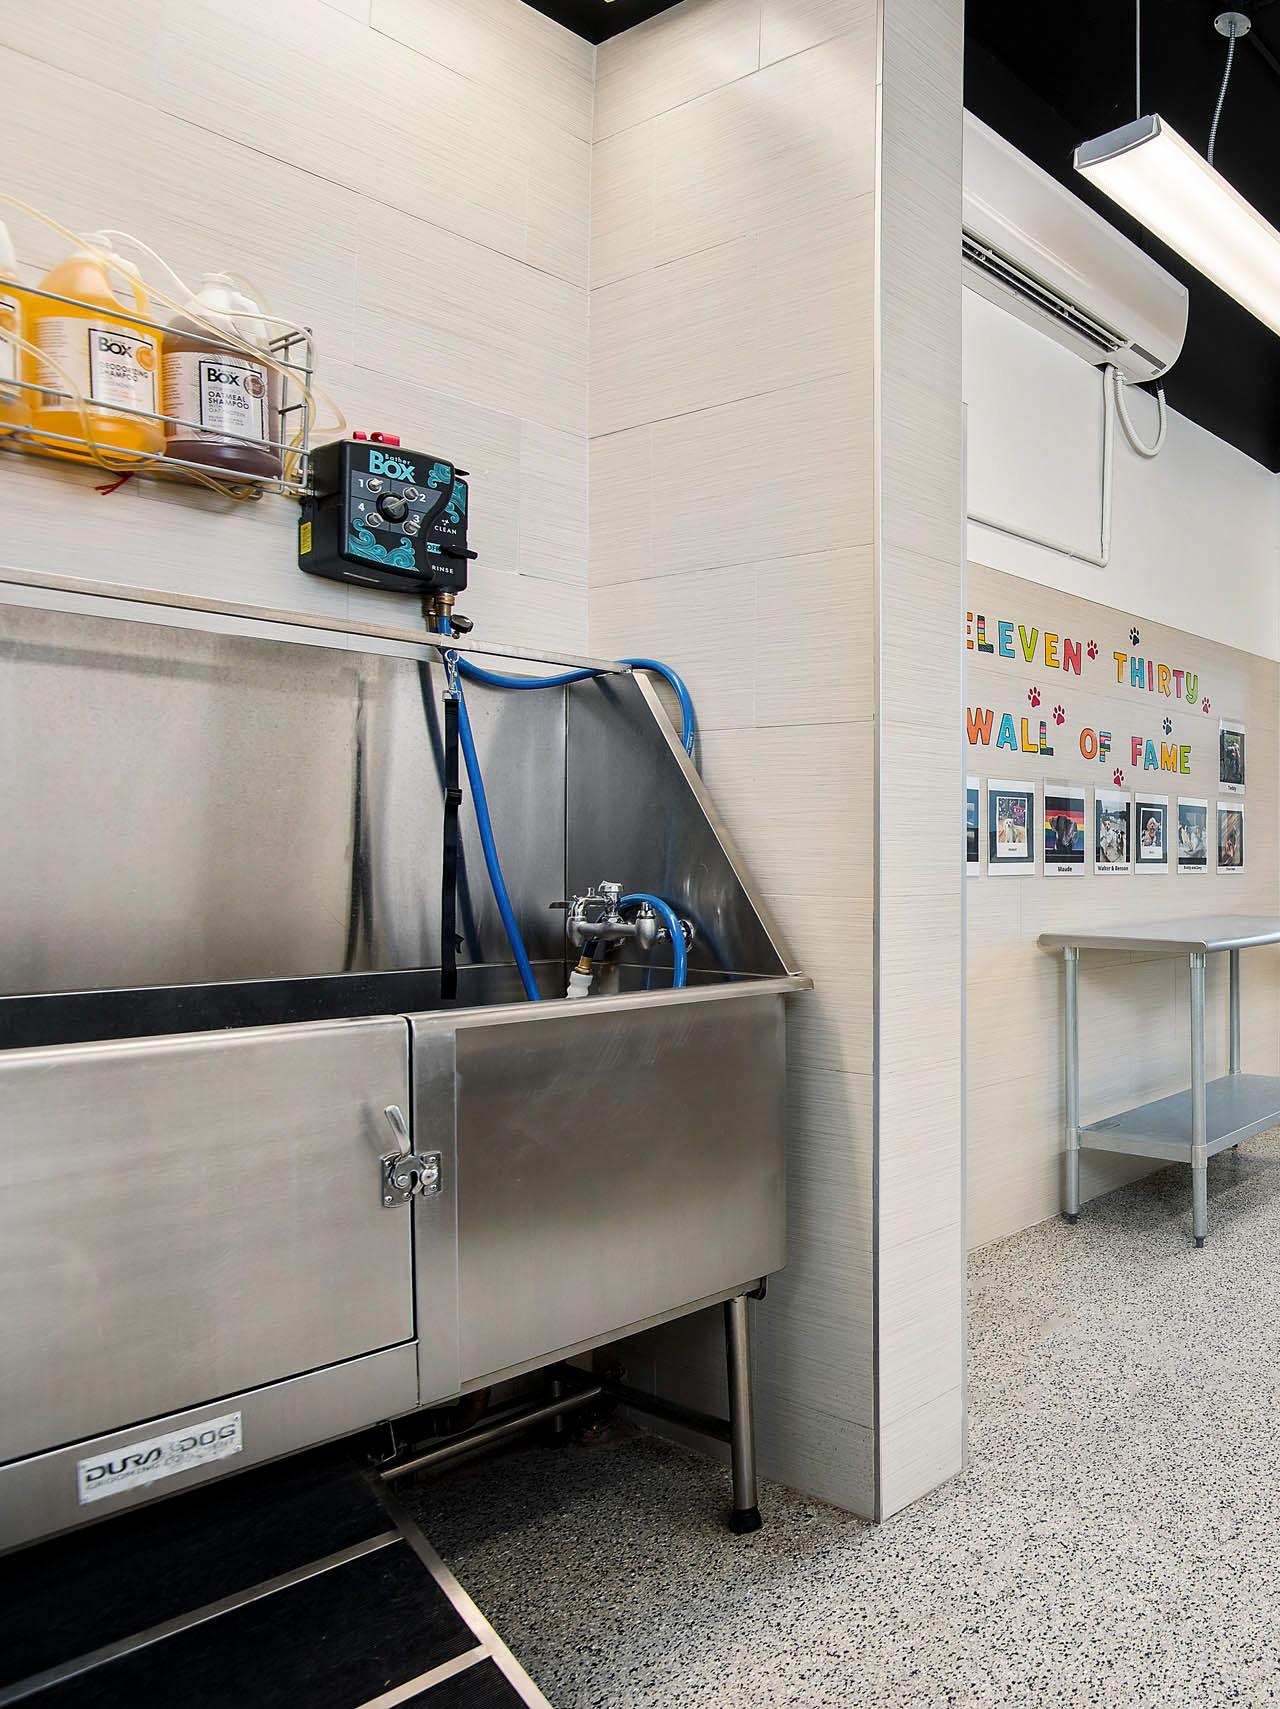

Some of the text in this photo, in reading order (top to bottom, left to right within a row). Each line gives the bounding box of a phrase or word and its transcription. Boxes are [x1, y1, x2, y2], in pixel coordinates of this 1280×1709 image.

[208, 391, 246, 403] OATMEAL
[208, 398, 249, 410] SHAMPOO
[384, 453, 411, 465] Bather
[369, 450, 416, 483] BOX
[358, 479, 364, 488] 1
[419, 494, 426, 502] 2
[358, 502, 365, 511] 4
[412, 514, 420, 523] 3
[434, 525, 457, 535] CLEAN
[432, 565, 454, 574] RINSE
[1113, 651, 1198, 704] THIRTY
[966, 707, 1191, 774] WALL OF FAME
[86, 1424, 236, 1482] DURA DOG
